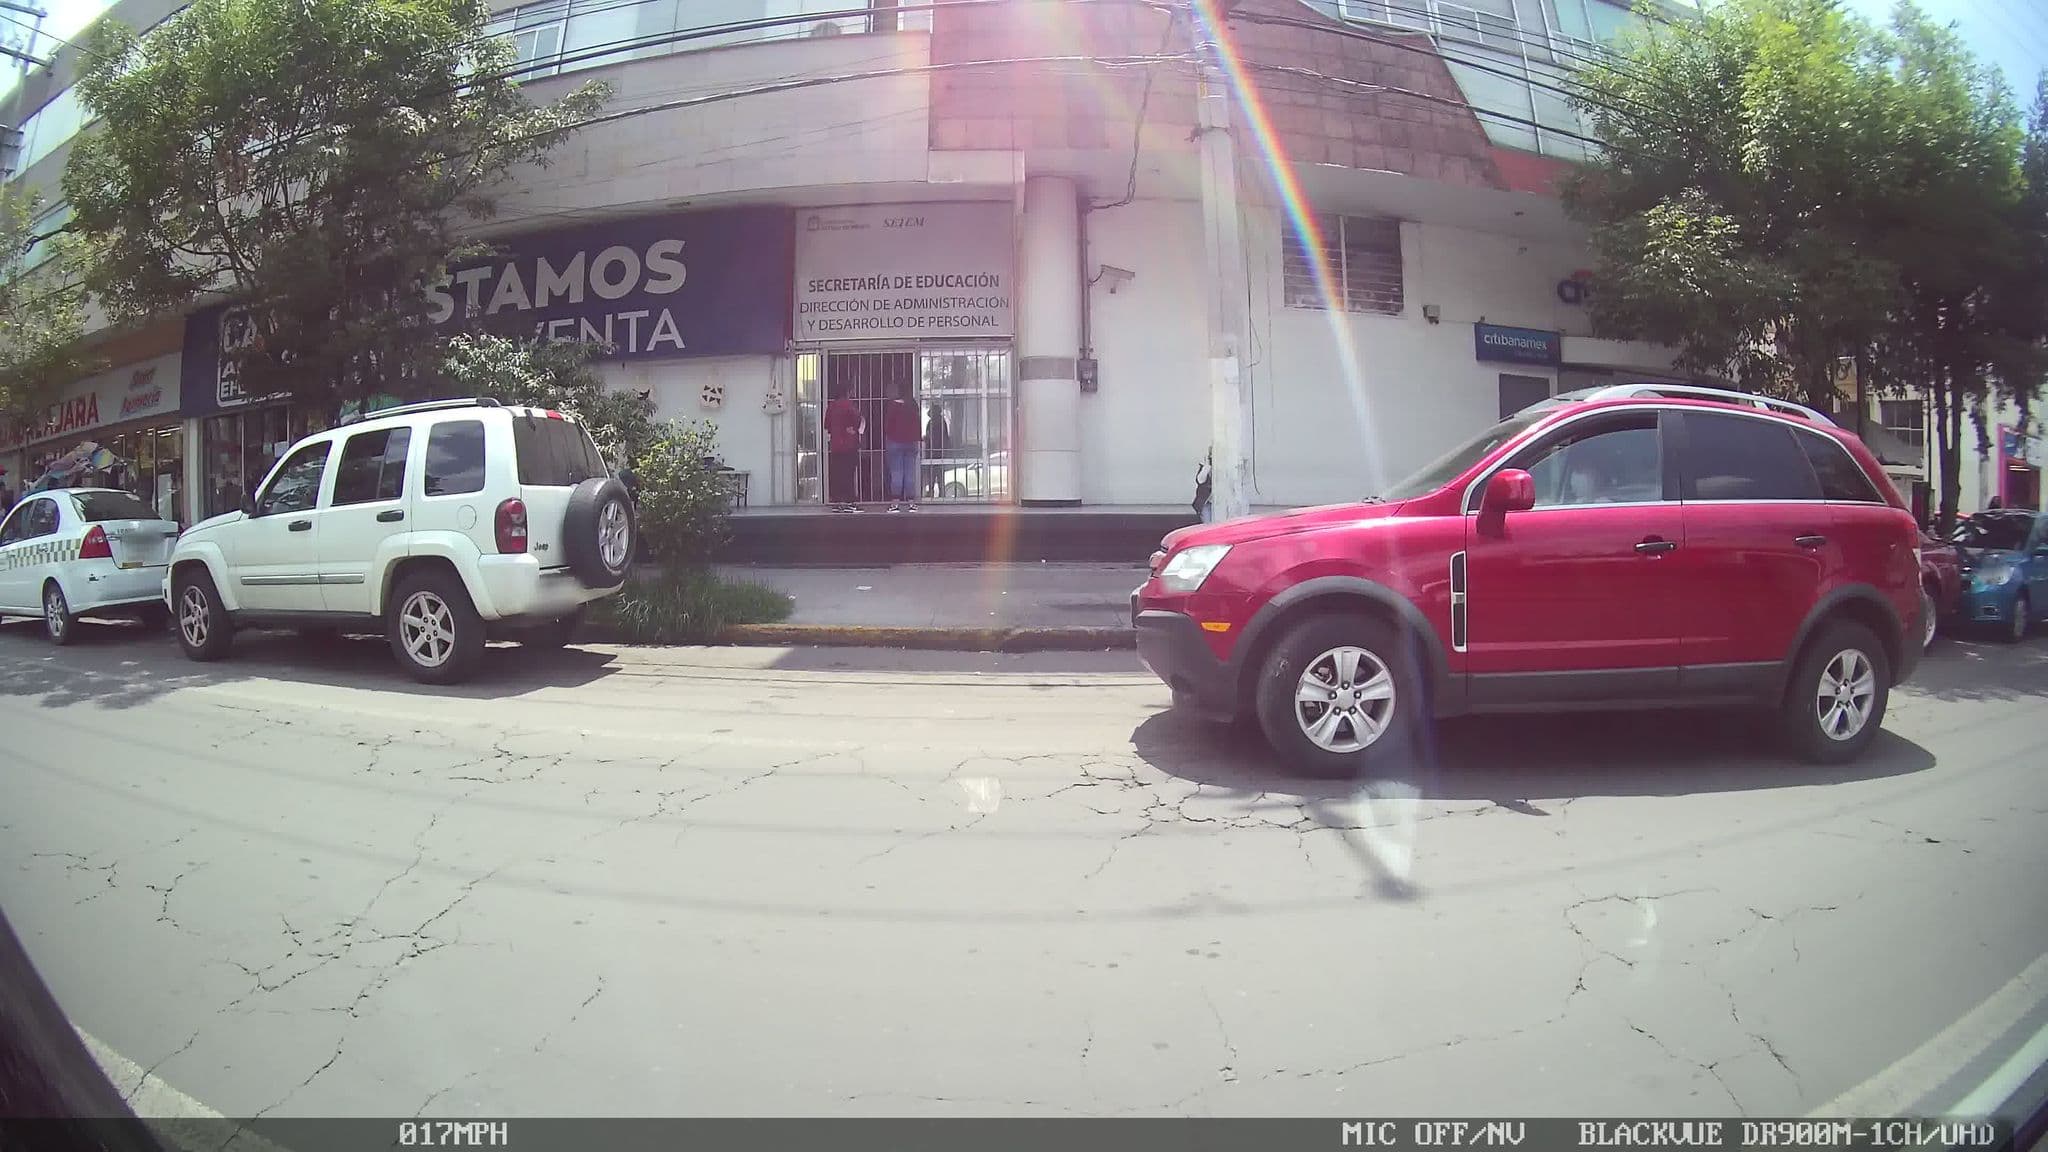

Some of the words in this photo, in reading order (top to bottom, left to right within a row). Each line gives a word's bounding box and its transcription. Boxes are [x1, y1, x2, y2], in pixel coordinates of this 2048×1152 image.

[808, 274, 890, 293] SECRETARÍA
[894, 275, 912, 290] DE
[916, 272, 1000, 289] EDUCACIÓN
[800, 299, 869, 314] DIRECCIÓN
[873, 299, 890, 311] DE
[894, 296, 1009, 309] ADMINISTRACIÓN
[807, 320, 816, 331] Y
[819, 317, 903, 331] DESARROLLO
[907, 316, 924, 328] DE
[928, 315, 999, 327] PERSONAL
[1484, 333, 1547, 350] citibanamex
